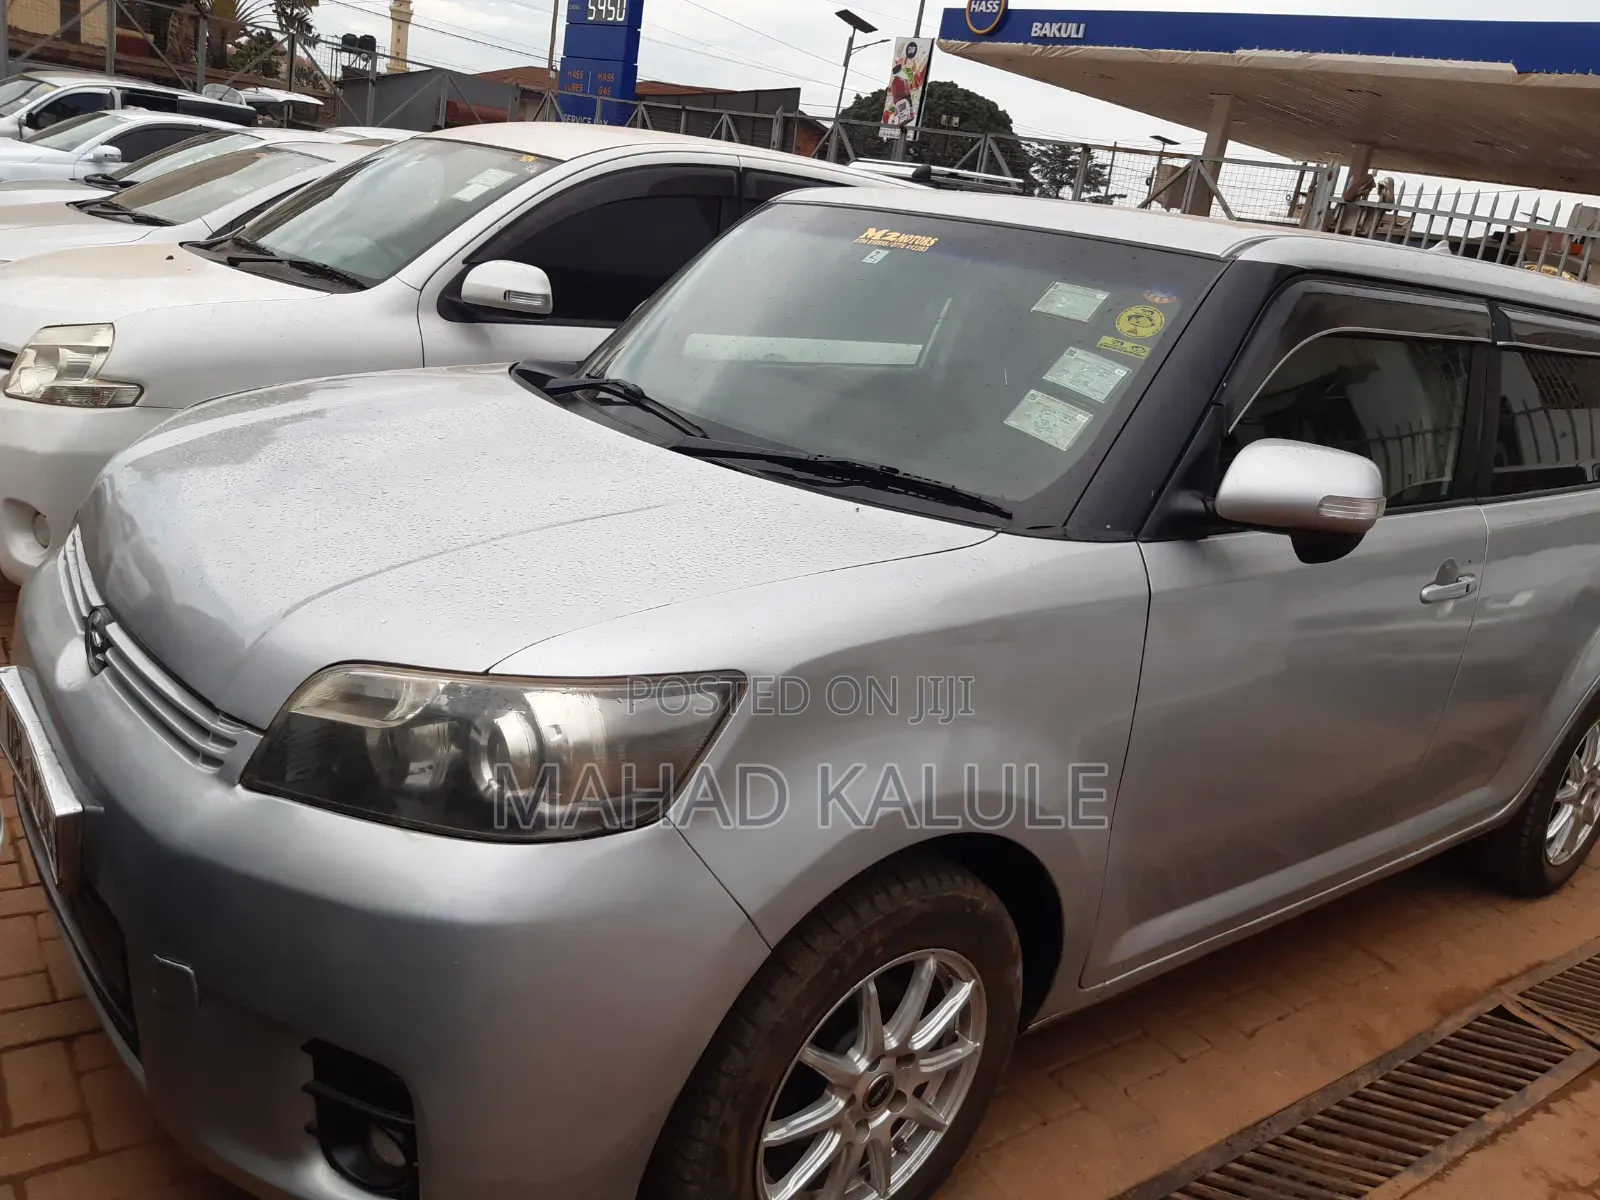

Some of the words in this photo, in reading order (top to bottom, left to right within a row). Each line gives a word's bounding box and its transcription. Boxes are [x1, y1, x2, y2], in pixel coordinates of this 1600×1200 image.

[970, 0, 1000, 12] HASS
[1030, 22, 1086, 38] BAKULI
[567, 69, 584, 79] HASS
[597, 72, 615, 82] HASS
[564, 83, 584, 92] LUBES
[597, 85, 611, 95] GAS
[895, 233, 939, 247] MOTORS
